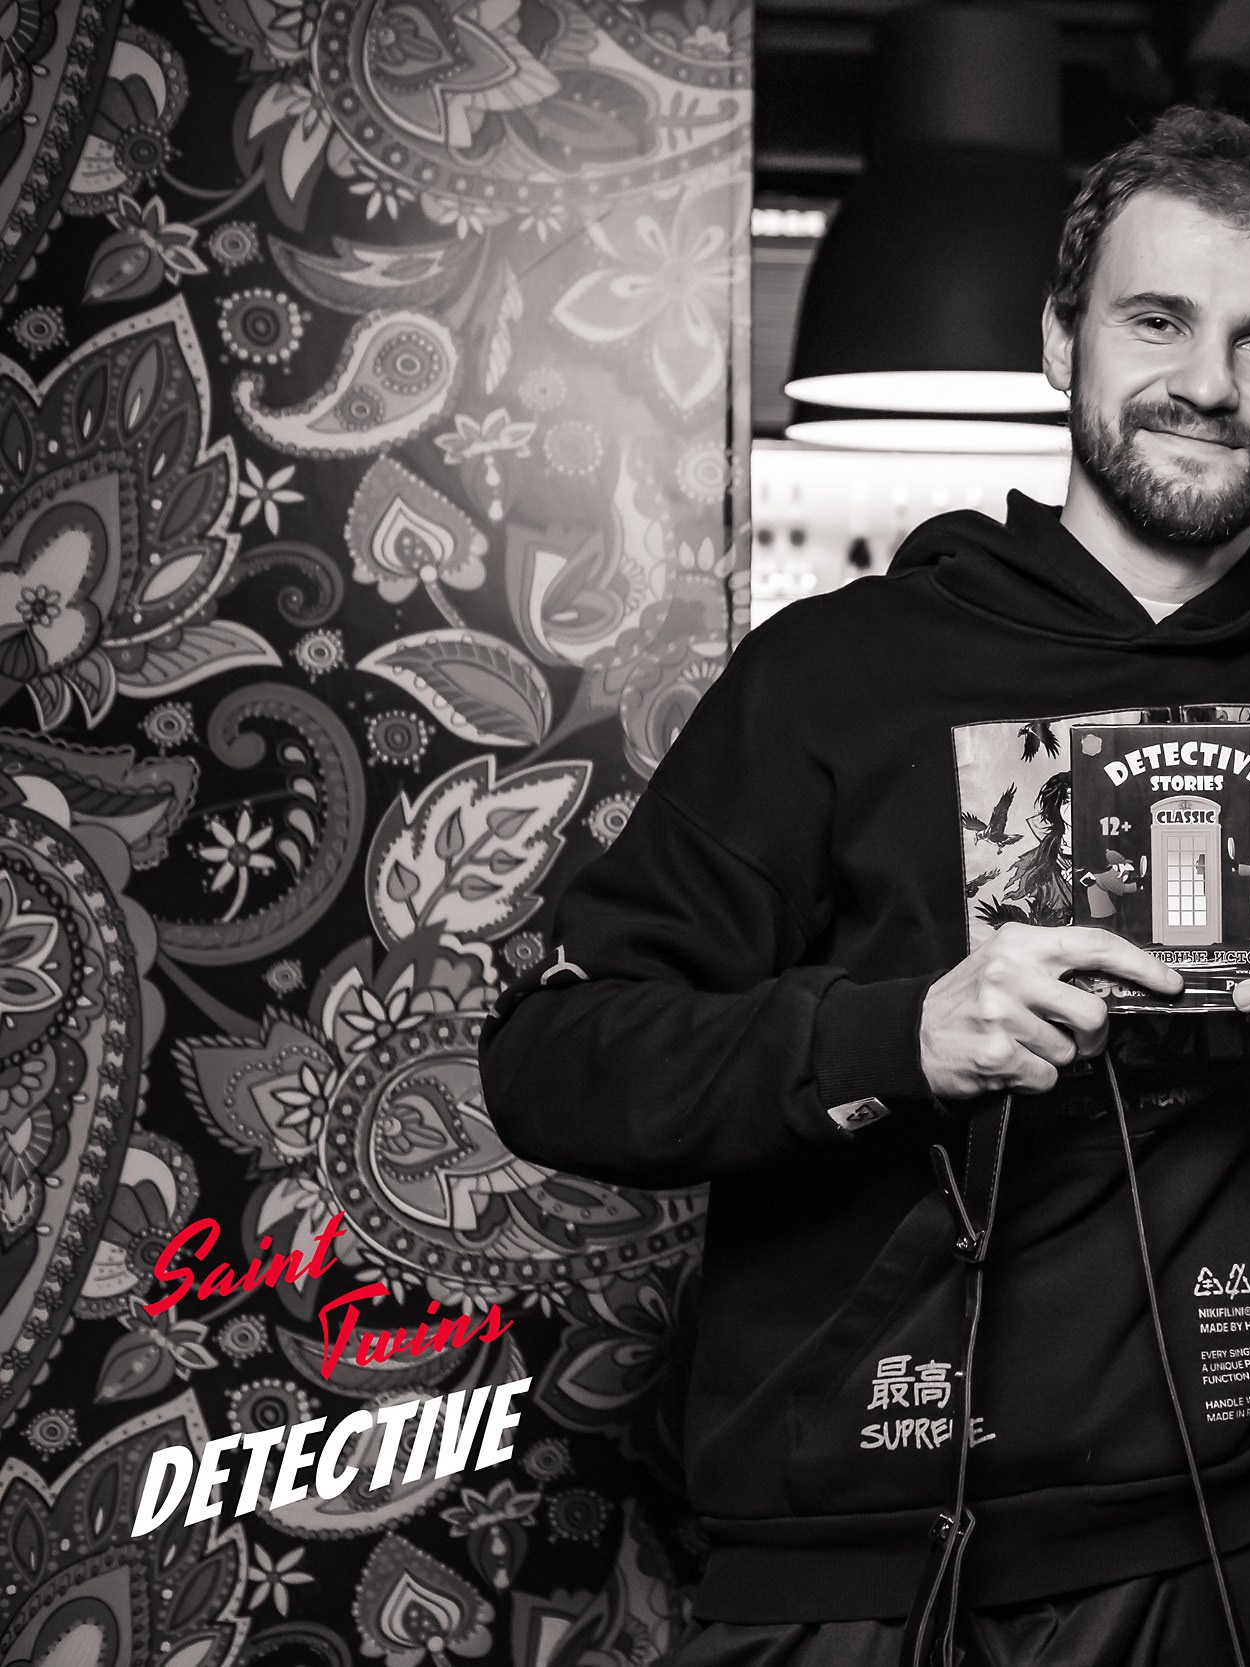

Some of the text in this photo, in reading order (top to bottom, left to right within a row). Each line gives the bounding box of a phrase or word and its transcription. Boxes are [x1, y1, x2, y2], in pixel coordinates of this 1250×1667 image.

[1150, 775, 1224, 791] STORIES
[1156, 810, 1216, 824] CLASSIC
[1100, 816, 1132, 836] 12+
[1200, 1323, 1229, 1333] MADE
[1230, 1322, 1243, 1332] BY
[1201, 1350, 1228, 1360] EVERY
[1202, 1363, 1209, 1372] A
[1210, 1360, 1244, 1372] UNIQUE
[867, 1354, 952, 1410] 最高
[1205, 1397, 1244, 1410] HANDLE
[1206, 1411, 1234, 1422] MADE
[1236, 1409, 1245, 1418] IN
[860, 1417, 996, 1451] SUPREE
